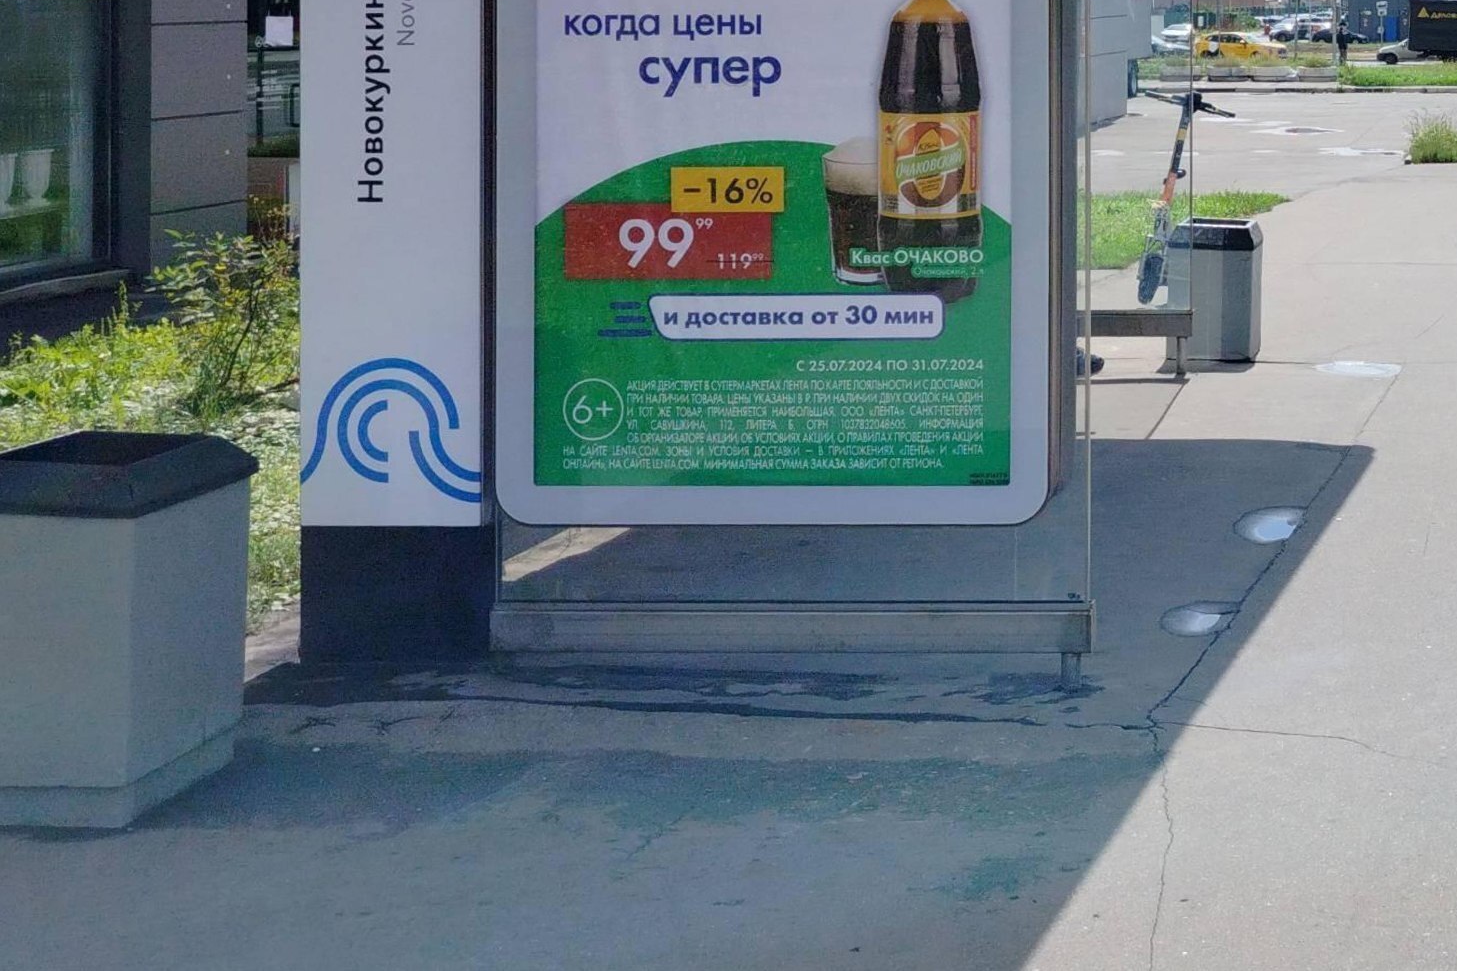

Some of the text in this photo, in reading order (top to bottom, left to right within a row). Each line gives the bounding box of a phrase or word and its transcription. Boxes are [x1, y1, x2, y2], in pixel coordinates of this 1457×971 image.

[564, 13, 762, 41] когда цены
[638, 54, 782, 98] супер
[851, 248, 984, 264] Квас ОЧАКОВО
[663, 305, 934, 329] и доставка от 30 мин
[796, 359, 984, 372] С 25.07.2024 ПО 31.07.2024
[657, 379, 703, 390] ДЕЙСТВУЕТ
[711, 379, 780, 390] СУПЕРМАРКЕТАХ
[783, 379, 808, 390] ЛЕНТА
[826, 379, 851, 390] КАРТЕ
[853, 379, 912, 390] ЛОЯЛЬНОСТИ
[930, 379, 983, 390] ДОСТАВКОЙ
[627, 393, 644, 404] ПРИ
[645, 393, 689, 404] НАЛИЧИИ
[727, 393, 751, 404] ЦЕНЫ
[754, 393, 796, 404] УКАЗАНЫ
[813, 393, 831, 404] ПРИ
[833, 393, 877, 404] НАЛИЧИИ
[879, 393, 900, 404] ДВУХ
[902, 393, 939, 404] СКИДОК
[957, 393, 983, 404] ОДИН
[572, 395, 614, 425] 6+
[639, 406, 653, 417] ТОТ
[707, 406, 767, 417] ПРИМЕНЯЕТСЯ
[841, 406, 864, 417] ООО
[746, 419, 777, 430] ЛИТЕРА
[806, 419, 829, 430] ОГРН
[920, 419, 983, 430] ИНФОРМАЦИЯ
[640, 432, 705, 443] ОРГАНИЗАТОРЕ
[755, 432, 801, 443] УСЛОВИЯХ
[847, 432, 892, 443] ПРАВИЛАХ
[894, 432, 951, 443] ПРОВЕДЕНИЯ
[951, 432, 983, 443] АКЦИИ
[580, 445, 608, 457] САЙТЕ
[666, 445, 692, 457] ЗОНЫ
[709, 445, 750, 457] УСЛОВИЯ
[753, 445, 800, 457] ДОСТАВКИ
[623, 458, 651, 469] САЙТЕ
[703, 458, 774, 469] МИНИМАЛЬНАЯ
[775, 458, 808, 469] СУММА
[810, 458, 846, 469] ЗАКАЗА
[847, 458, 889, 469] ЗАВИСИТ
